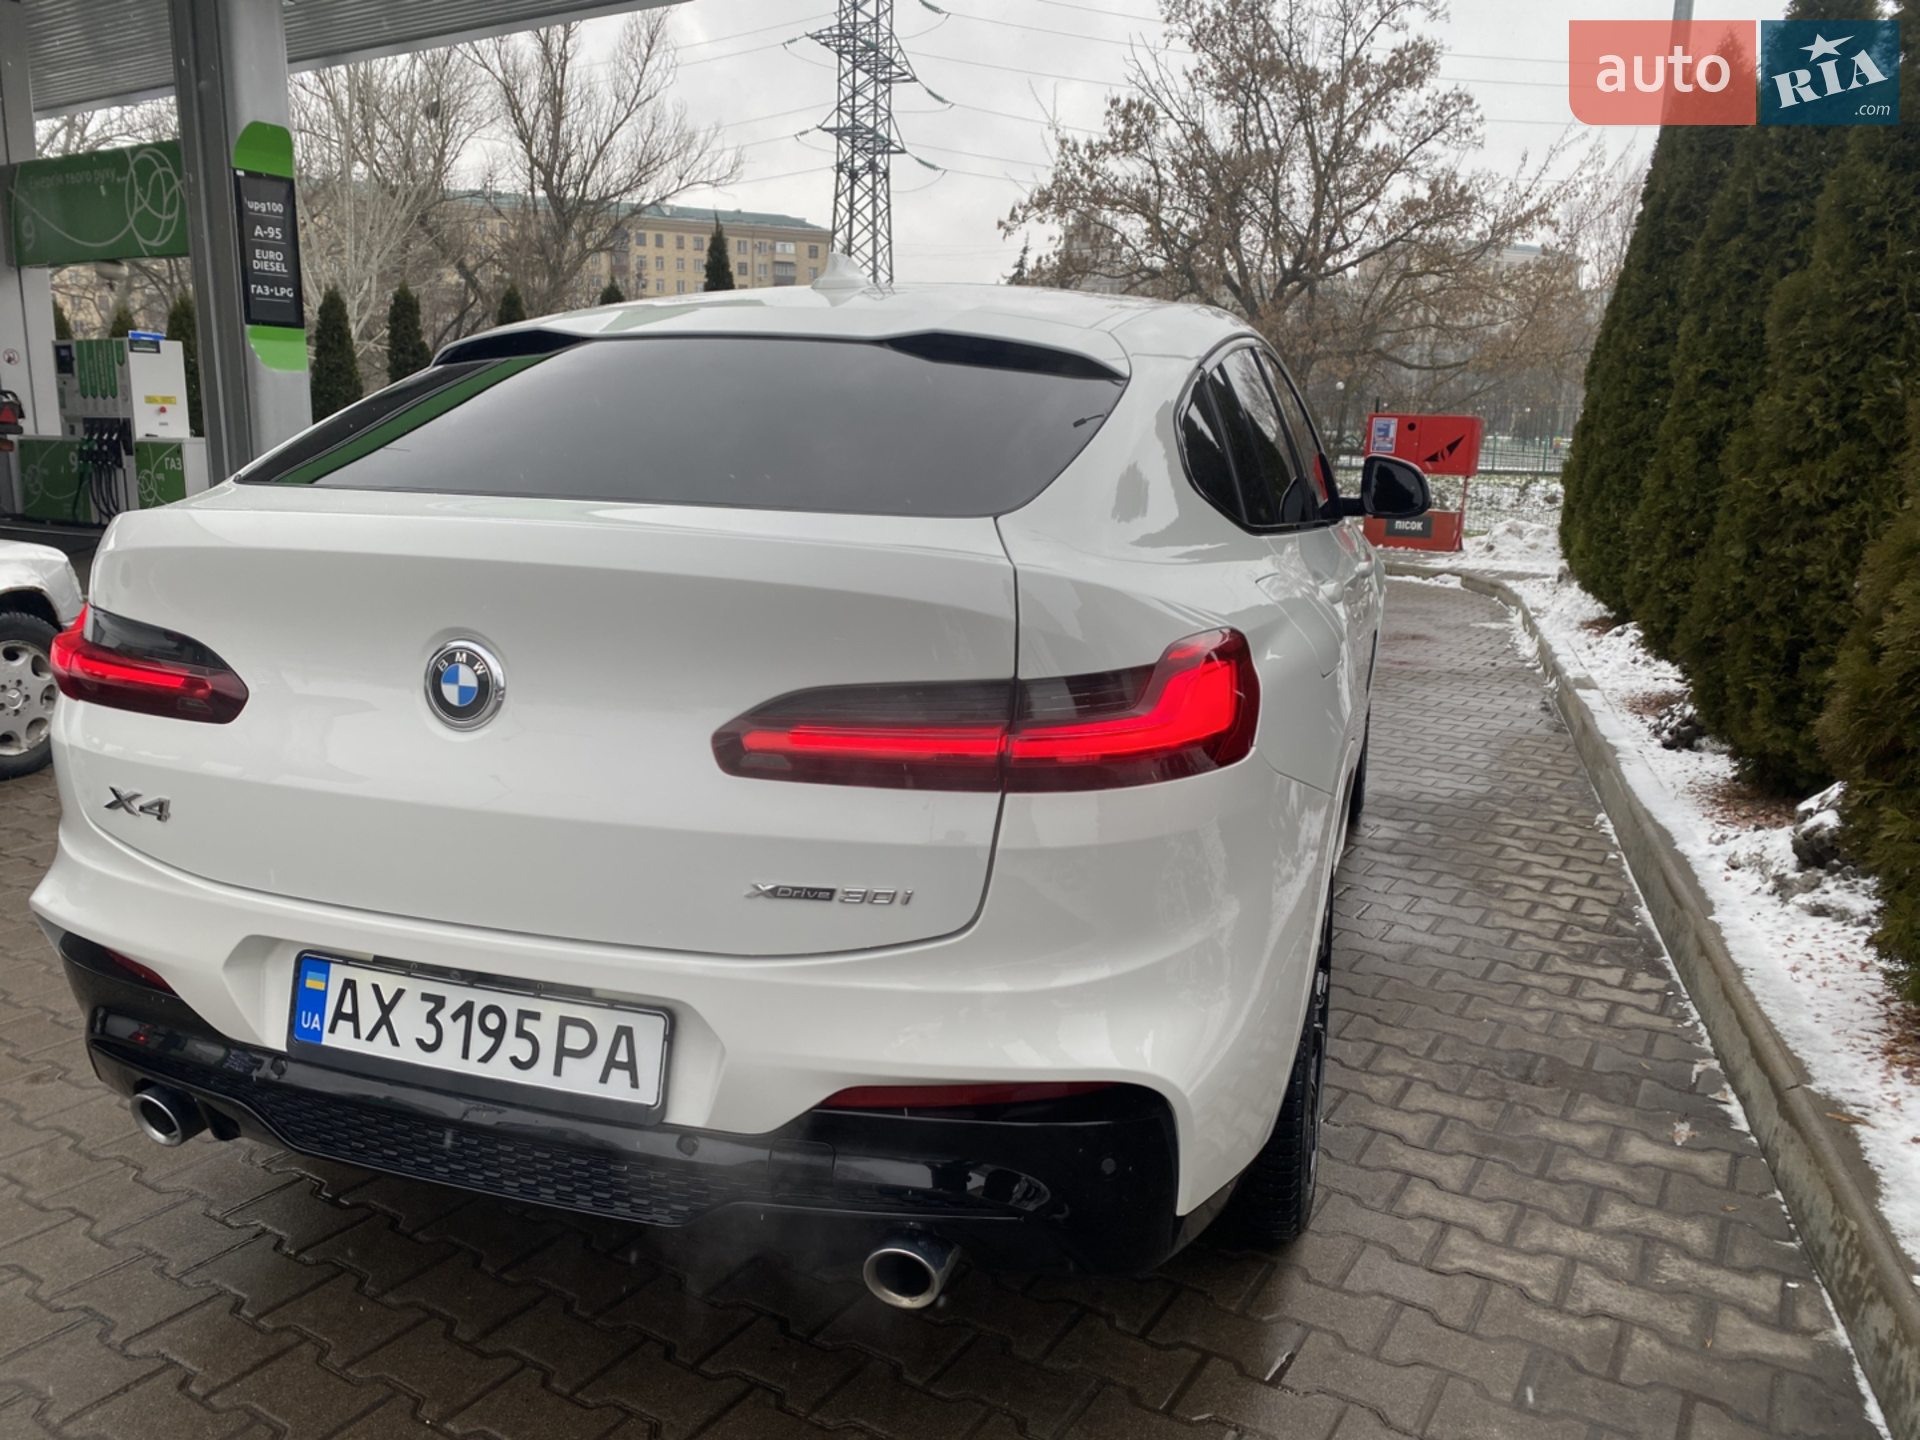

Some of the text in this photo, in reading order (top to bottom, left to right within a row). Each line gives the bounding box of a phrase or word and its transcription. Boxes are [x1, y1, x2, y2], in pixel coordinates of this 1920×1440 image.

[254, 225, 282, 239] A-95
[255, 249, 283, 261] EURO
[252, 260, 288, 273] DIESEL
[164, 457, 182, 471] ГАЗ
[437, 651, 486, 676] BMW
[103, 786, 171, 822] X4
[301, 1010, 322, 1031] UA
[328, 977, 640, 1089] AX 3195 PA
